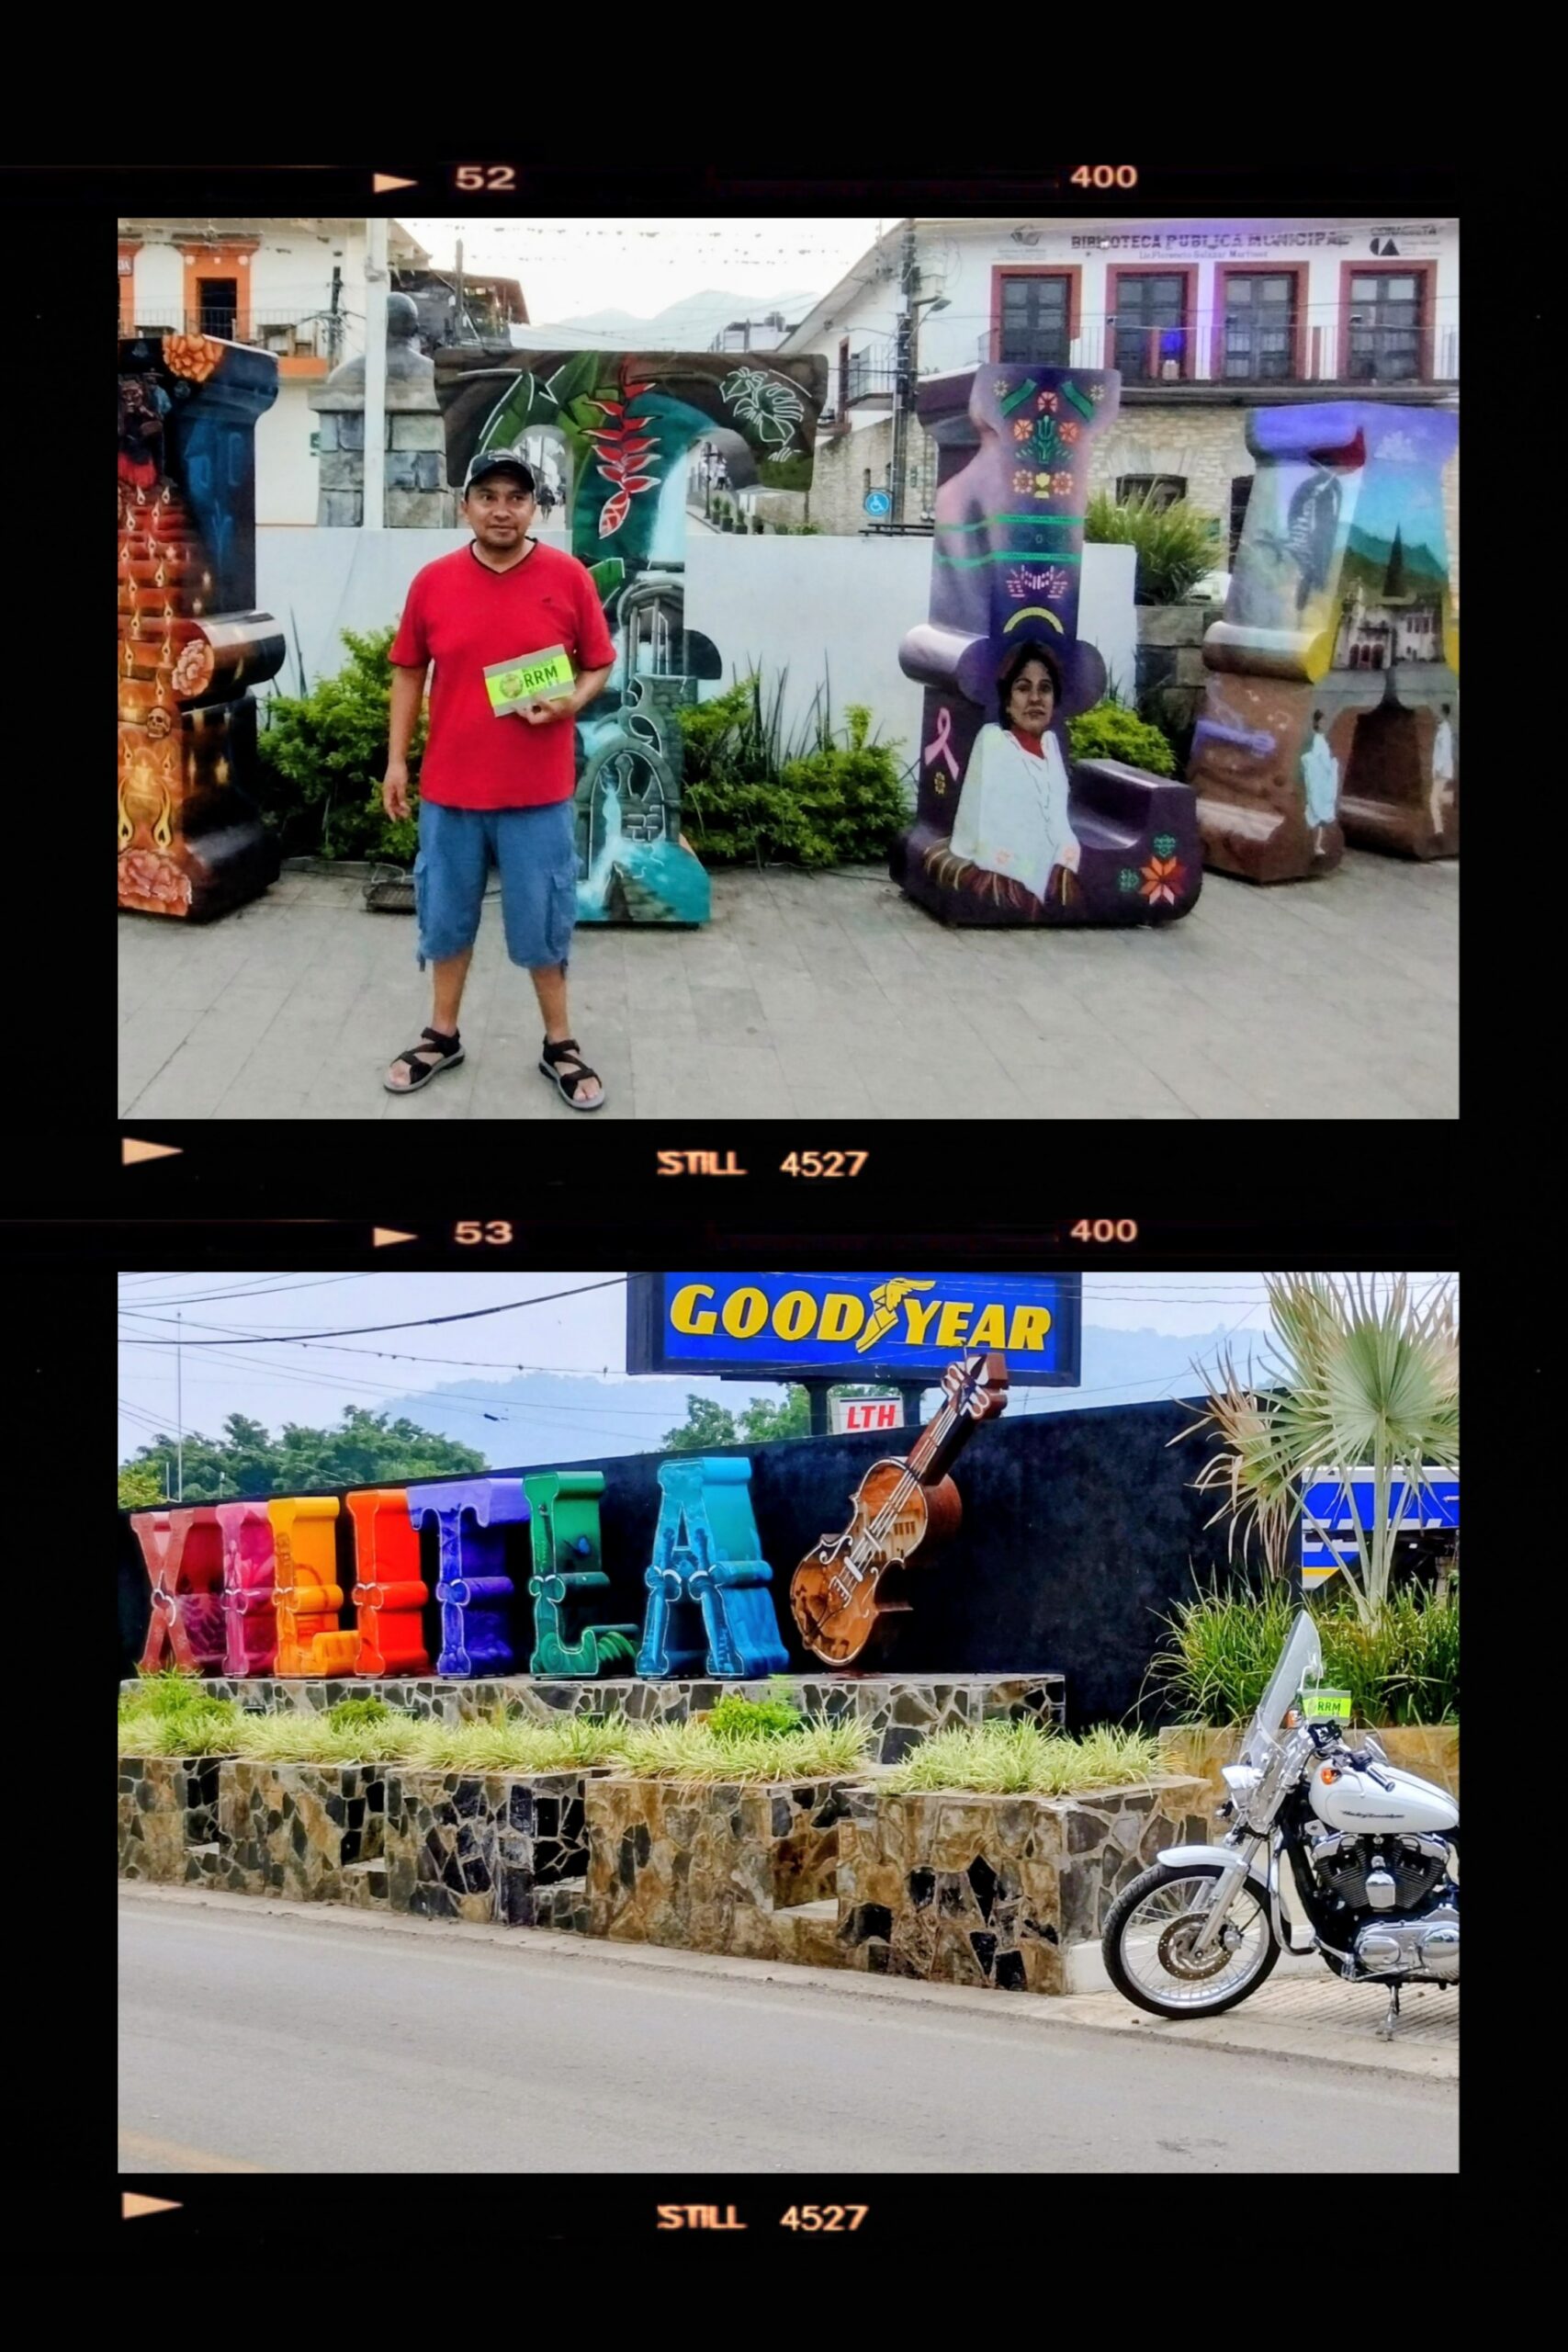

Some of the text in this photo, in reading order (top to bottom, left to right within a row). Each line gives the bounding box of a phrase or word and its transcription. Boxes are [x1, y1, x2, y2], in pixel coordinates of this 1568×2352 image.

[523, 664, 559, 688] RRM
[847, 1404, 897, 1429] LTH
[1317, 1701, 1341, 1712] RRM
